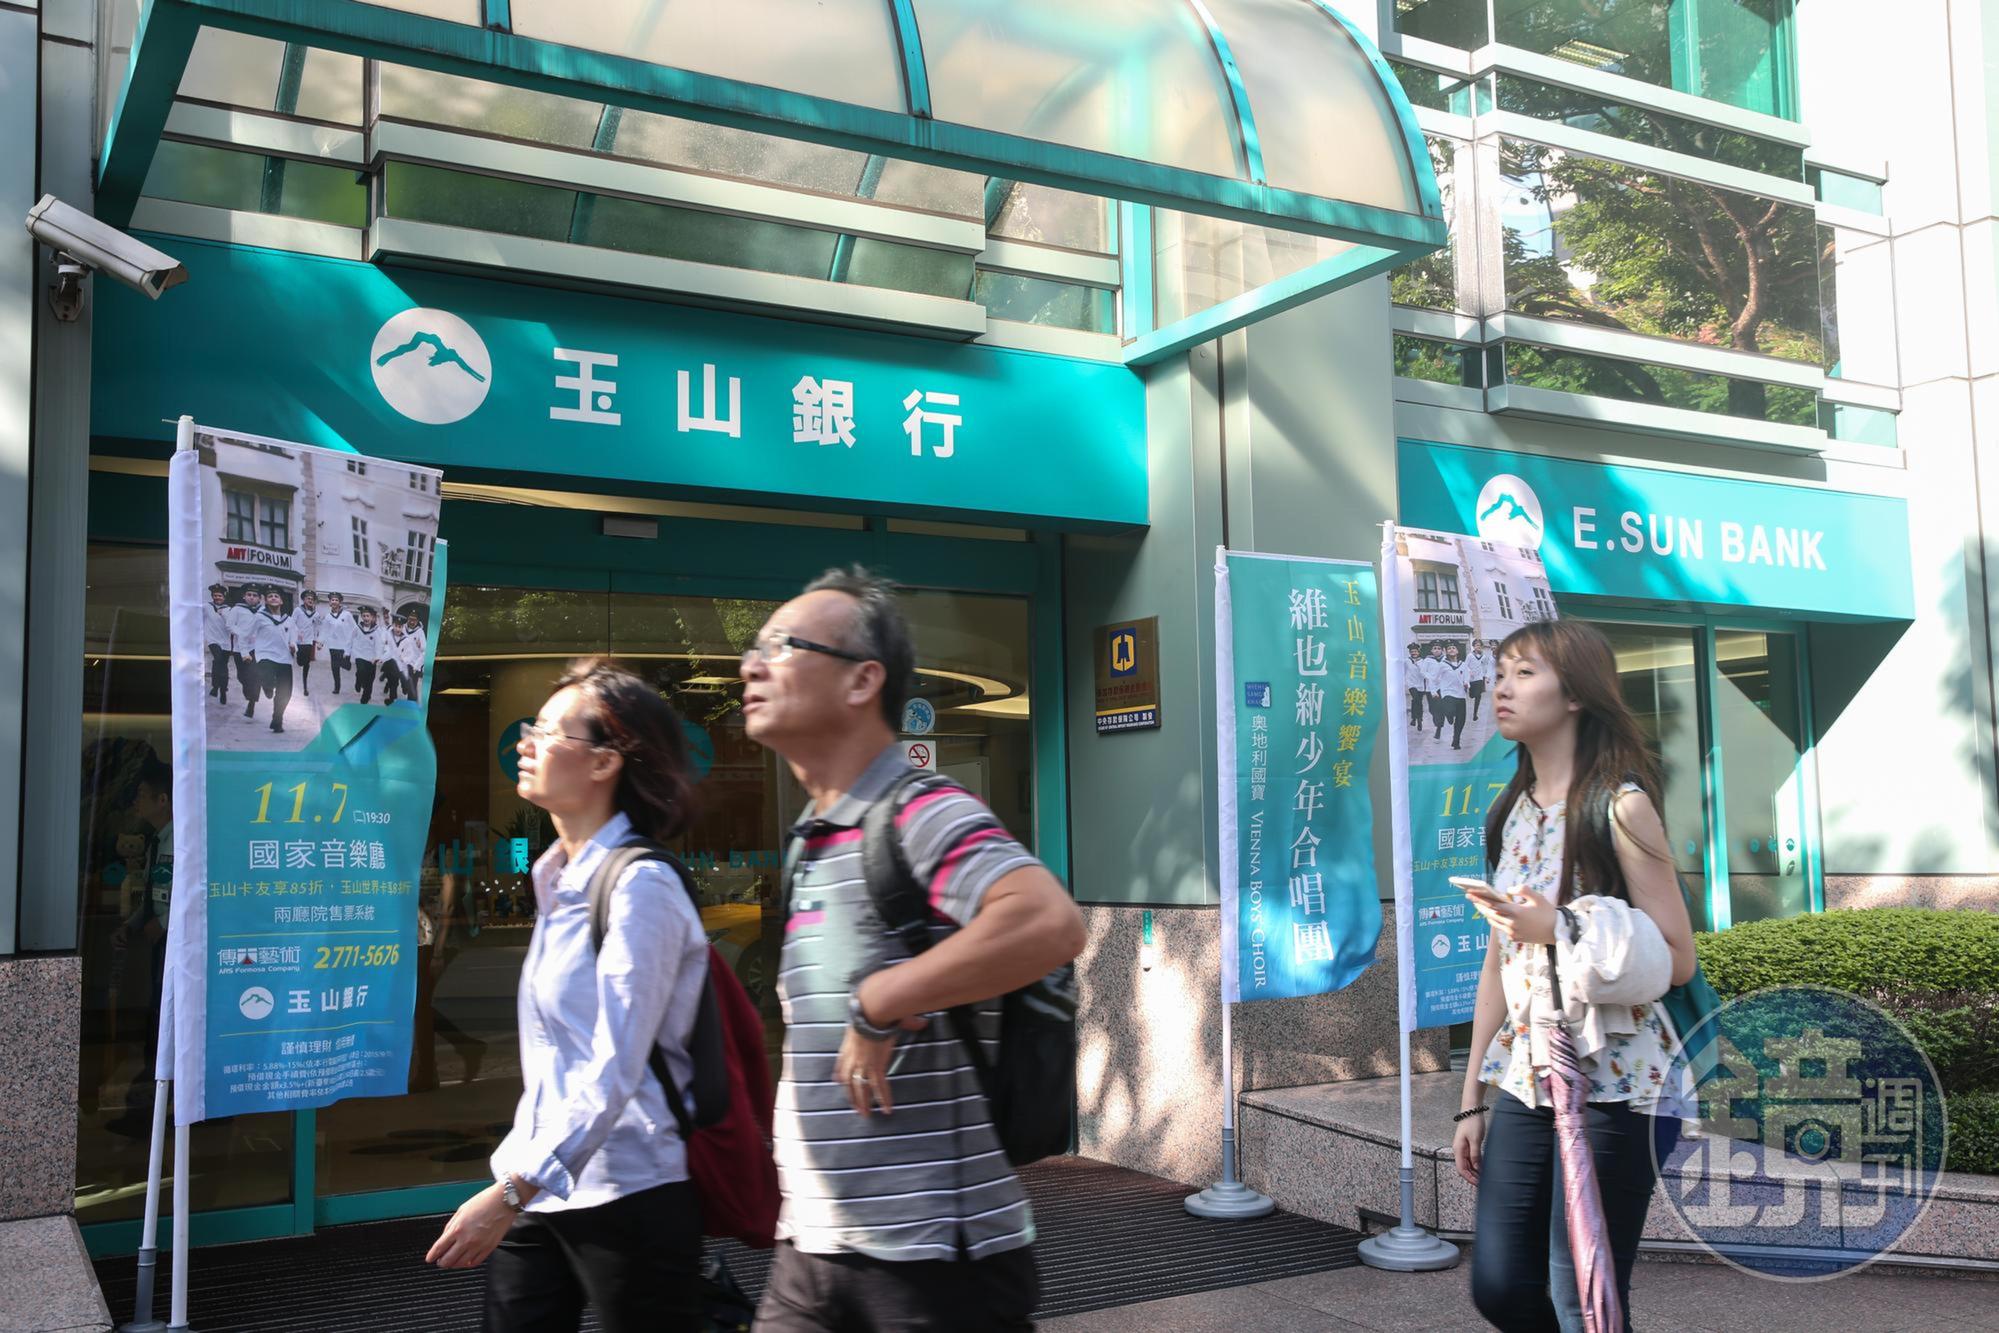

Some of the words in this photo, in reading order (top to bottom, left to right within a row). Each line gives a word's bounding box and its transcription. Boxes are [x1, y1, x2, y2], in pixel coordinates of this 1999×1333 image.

[550, 347, 963, 457] 玉山銀行
[250, 549, 289, 568] FORUM
[1572, 506, 1702, 560] E.SUN
[1720, 522, 1827, 571] BANK
[1434, 614, 1464, 625] FORUM
[1333, 580, 1368, 788] 玉山音樂饗宴
[1288, 588, 1335, 965] 維也納少年合唱團
[250, 782, 348, 824] 11.7
[249, 838, 386, 870] 國家音樂廳
[1250, 811, 1265, 875] VIENNA
[274, 904, 375, 923] 兩廳院售票系統
[314, 943, 400, 969] 2771-5676
[1251, 929, 1267, 989] CHOIR
[288, 985, 369, 1013] 玉山銀行
